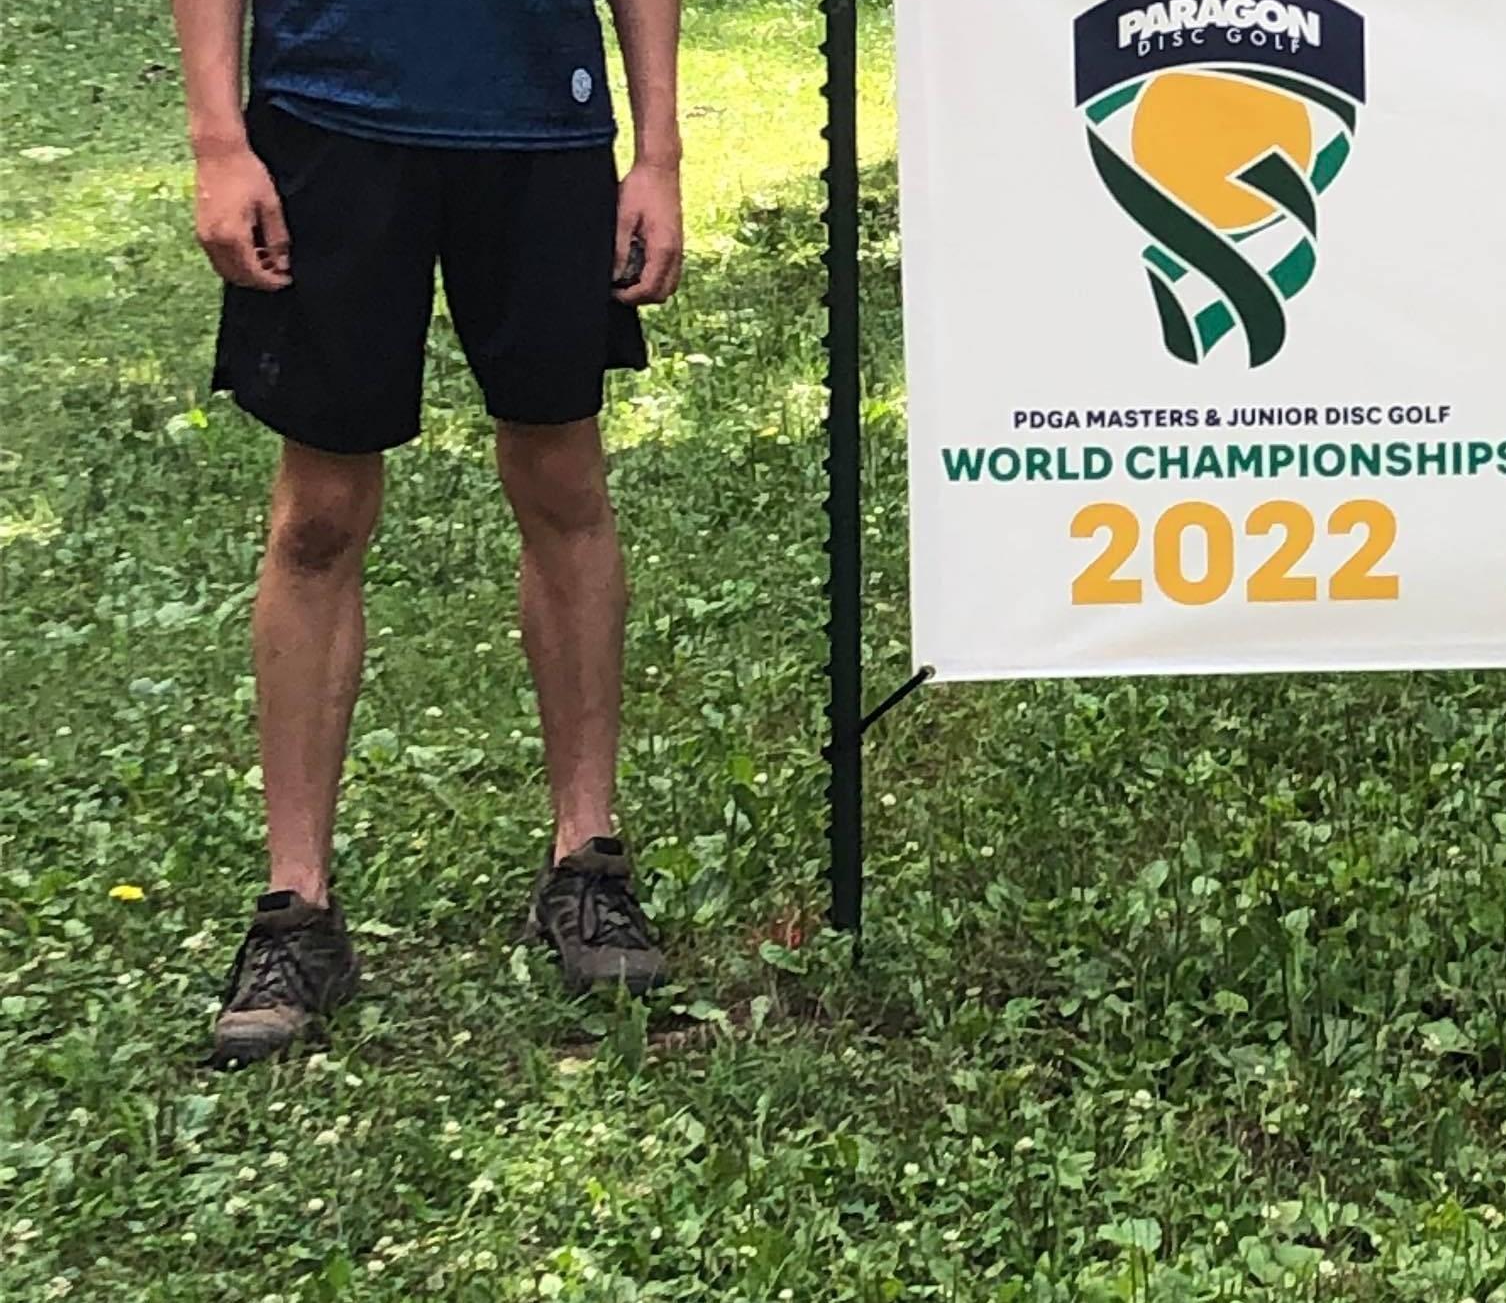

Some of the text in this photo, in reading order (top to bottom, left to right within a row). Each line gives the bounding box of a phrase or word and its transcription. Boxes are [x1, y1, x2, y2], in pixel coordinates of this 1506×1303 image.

[1137, 28, 1300, 57] DISC GOLF
[1013, 405, 1451, 429] PDGA MASTERS & JUNIOR DISC GOLF
[942, 446, 1112, 482] WORLD
[1069, 498, 1399, 605] 2022
